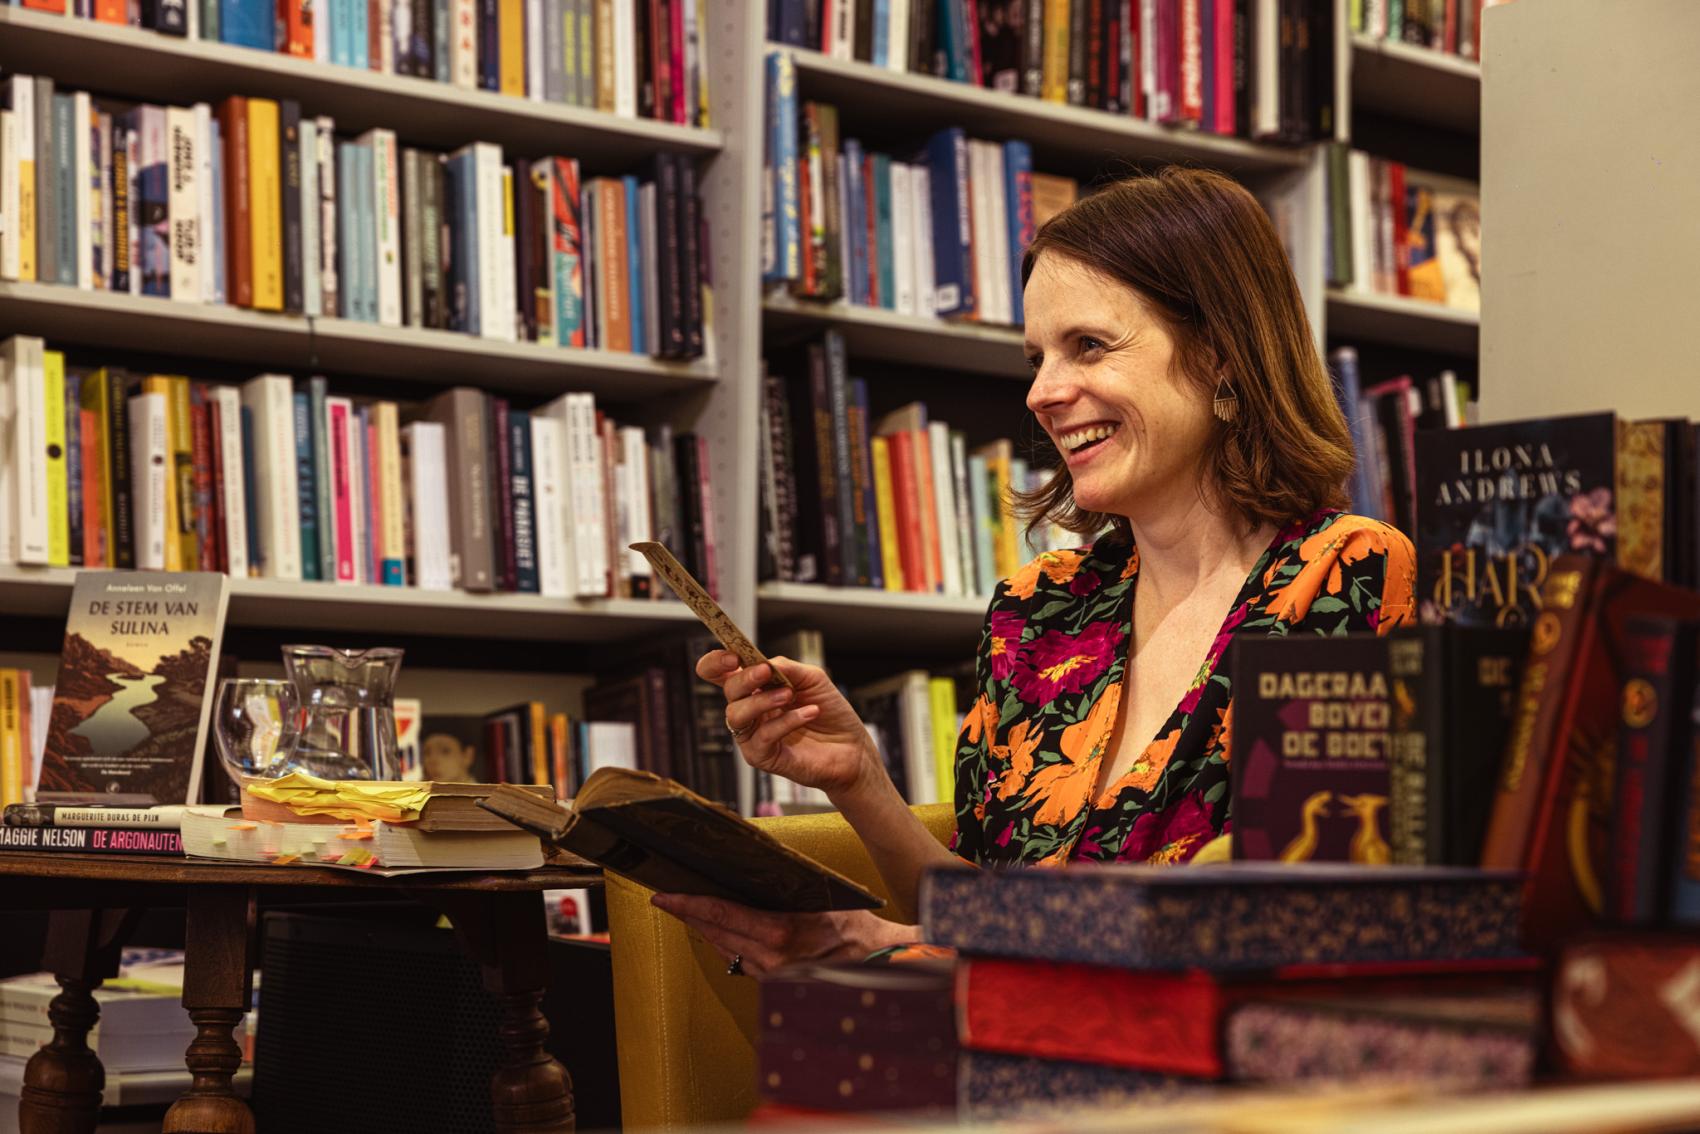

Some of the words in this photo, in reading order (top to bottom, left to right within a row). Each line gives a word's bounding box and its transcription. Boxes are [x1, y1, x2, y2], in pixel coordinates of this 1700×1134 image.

[1460, 443, 1553, 475] ILONA
[1436, 470, 1582, 506] ANDREWS
[106, 583, 144, 592] Anneleen
[146, 584, 162, 592] Van
[165, 583, 187, 593] Offel
[1434, 543, 1546, 616] HAR
[88, 601, 110, 615] DE
[115, 601, 158, 616] STEM
[164, 602, 198, 616] VAN
[110, 620, 169, 635] SULINA
[1259, 673, 1389, 699] DAGERAA
[1282, 732, 1319, 757] DE
[61, 812, 104, 822] MARGUERITE
[107, 813, 130, 822] DURAS
[132, 814, 141, 822] DE
[143, 814, 160, 822] PIJN
[42, 829, 86, 847] NELSON
[93, 830, 107, 848] DE
[109, 831, 183, 851] ARGONAUTEN
